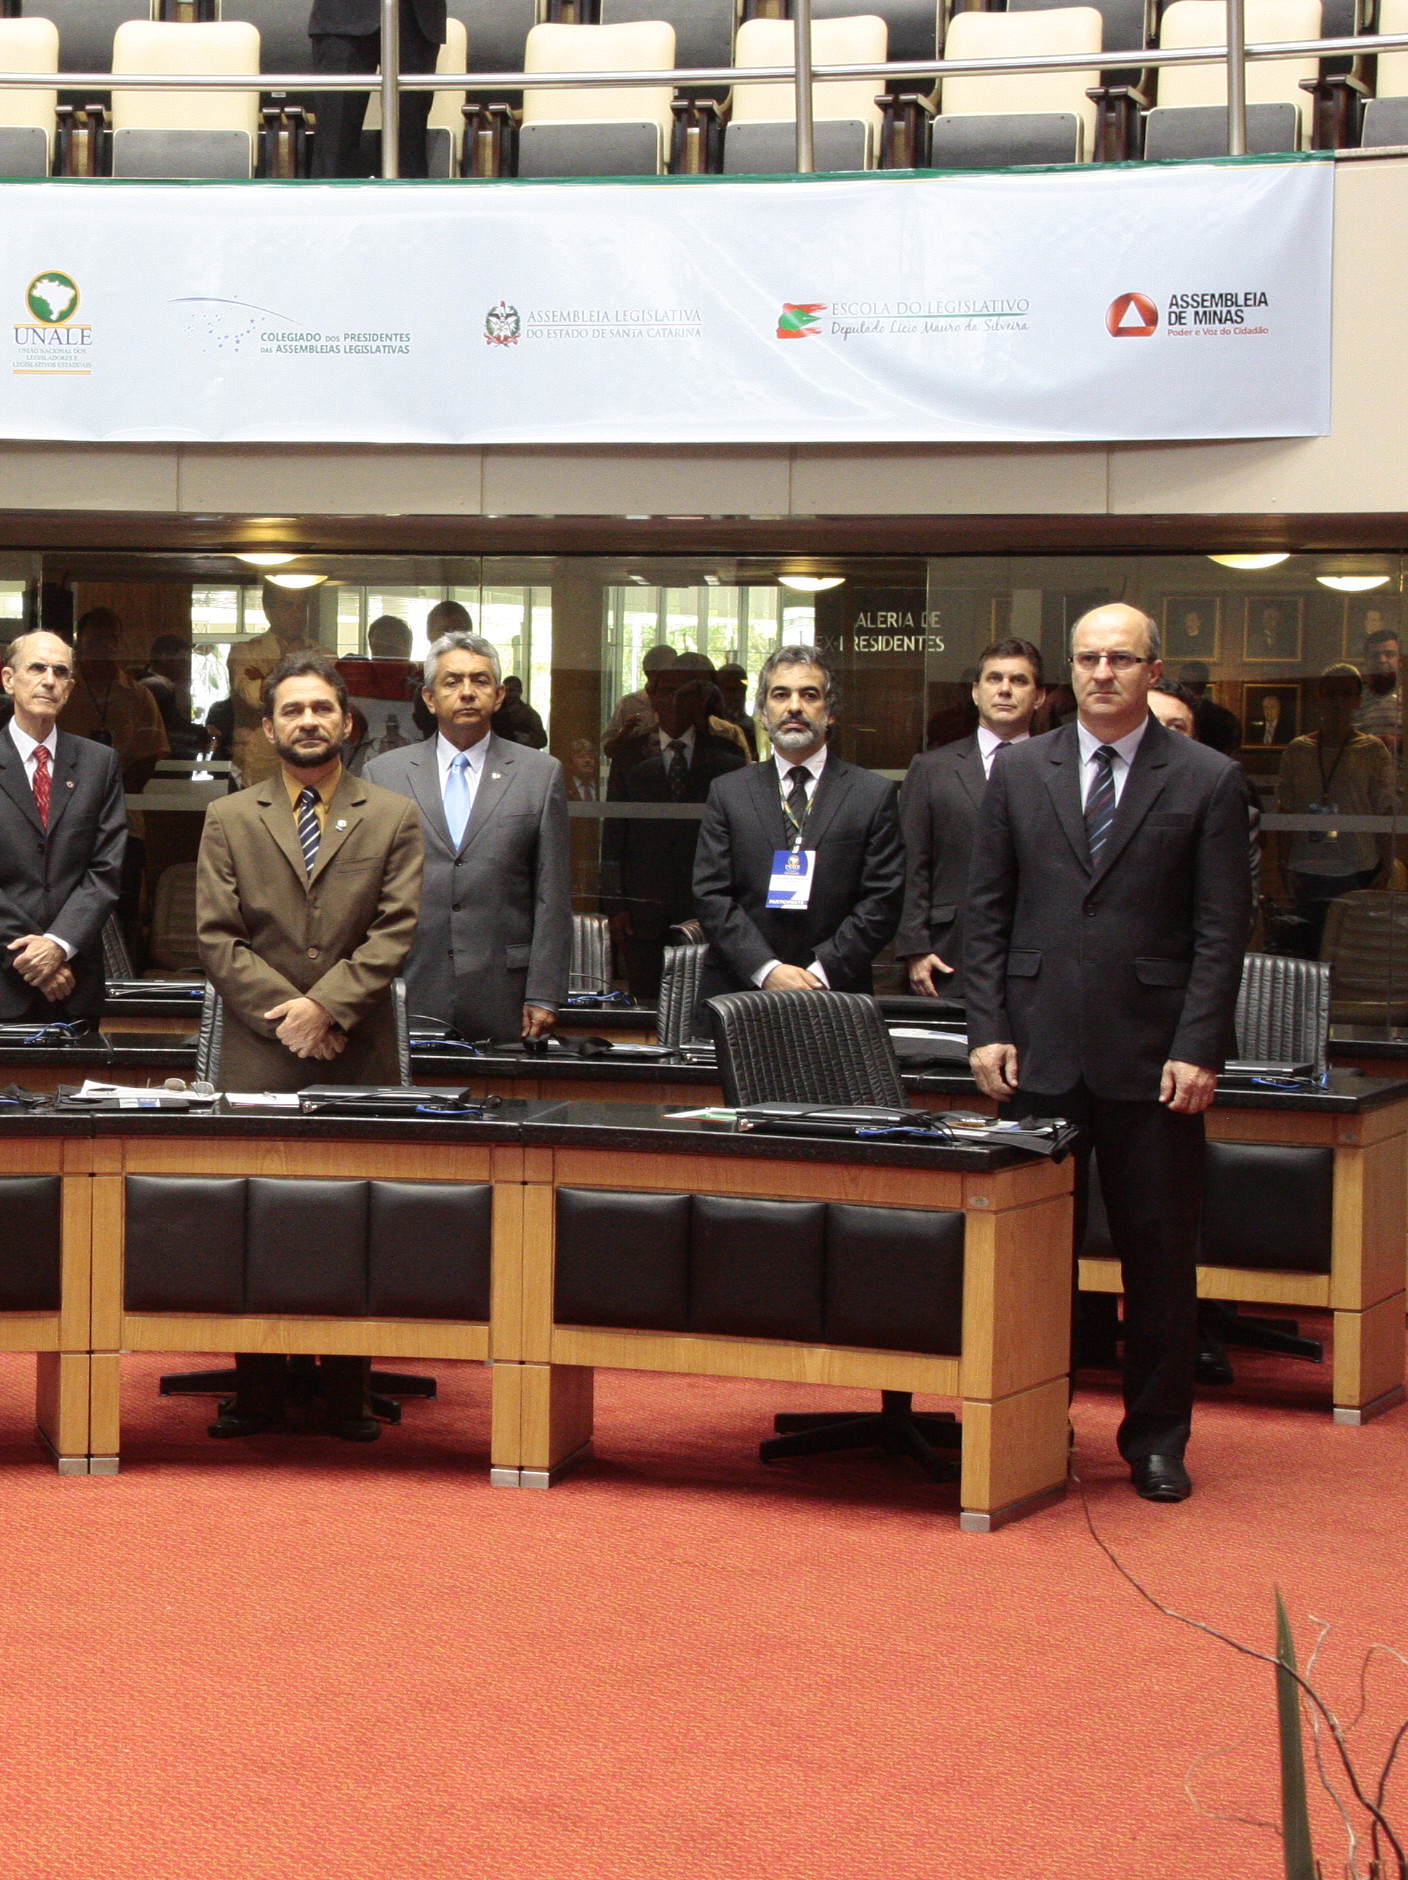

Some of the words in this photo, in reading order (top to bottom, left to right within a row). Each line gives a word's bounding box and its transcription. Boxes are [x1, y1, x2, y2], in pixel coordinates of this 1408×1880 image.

[832, 302, 890, 315] ESCOLA
[896, 302, 921, 314] DO
[928, 299, 1029, 314] LEGISLATIVO
[1169, 292, 1268, 309] ASSEMBLEIA
[527, 310, 610, 322] ASSEMBLEIA
[615, 310, 701, 322] LEGISLATIVA
[1168, 311, 1187, 326] DE
[1194, 309, 1244, 325] MINAS
[13, 328, 93, 345] UNALE
[261, 332, 321, 342] COLEGIADO
[344, 333, 411, 342] PRESIDENTES
[526, 329, 543, 338] DO
[547, 329, 588, 338] ESTADO
[592, 329, 606, 338] DE
[610, 329, 643, 338] SANTA
[647, 328, 701, 338] CATARINA
[831, 321, 884, 341] Deputado
[889, 321, 917, 333] Lício
[920, 321, 960, 334] Mauro
[964, 319, 978, 331] da
[984, 317, 1029, 331] Silveira
[276, 345, 341, 354] ASSEMBLEIAS
[344, 345, 410, 354] LEGISLATIVAS
[855, 612, 914, 628] ALERIA
[816, 636, 945, 652] EX-RESIDENTES
